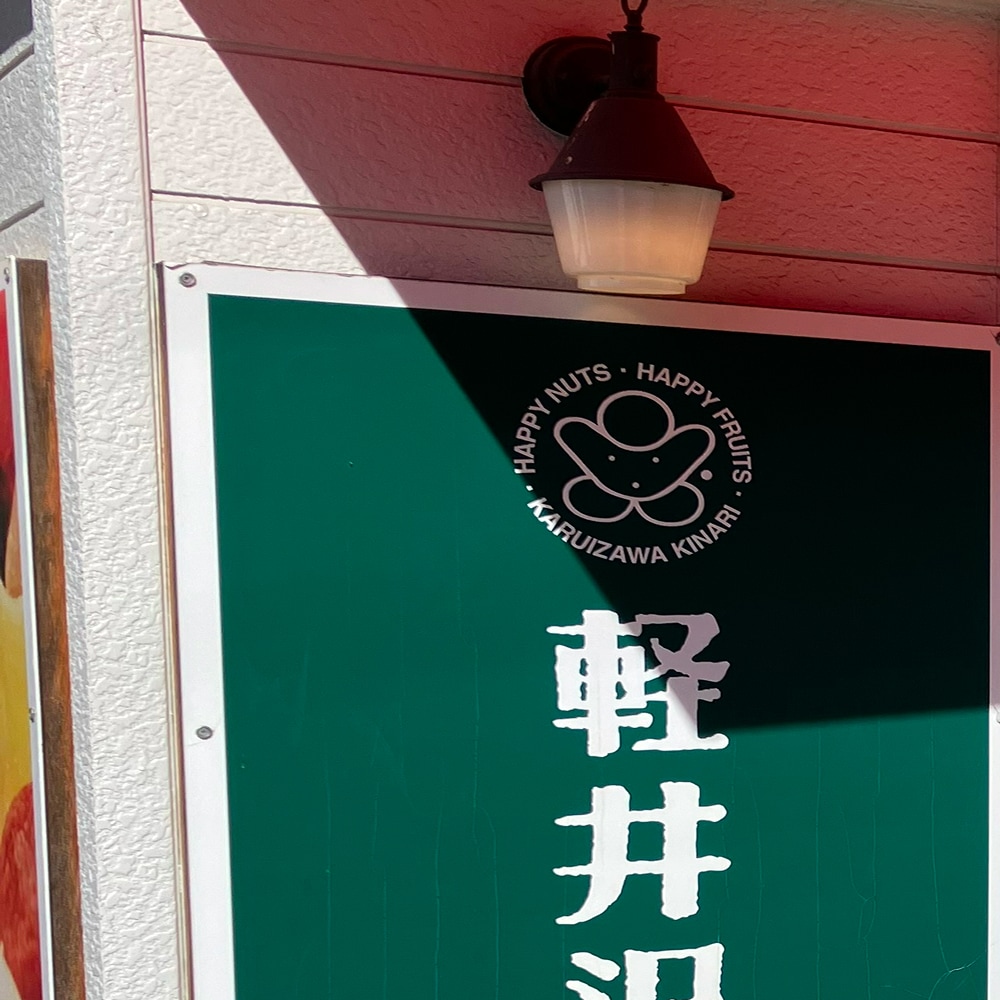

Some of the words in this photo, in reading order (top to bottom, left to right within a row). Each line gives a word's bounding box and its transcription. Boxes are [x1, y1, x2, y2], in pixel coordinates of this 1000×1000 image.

[513, 398, 551, 475] HAPPY
[544, 363, 612, 404] NUTS
[637, 362, 721, 408] HAPPY
[712, 407, 752, 484] FRUITS
[527, 497, 669, 564] KARUIZAWA
[670, 504, 741, 559] KINARI
